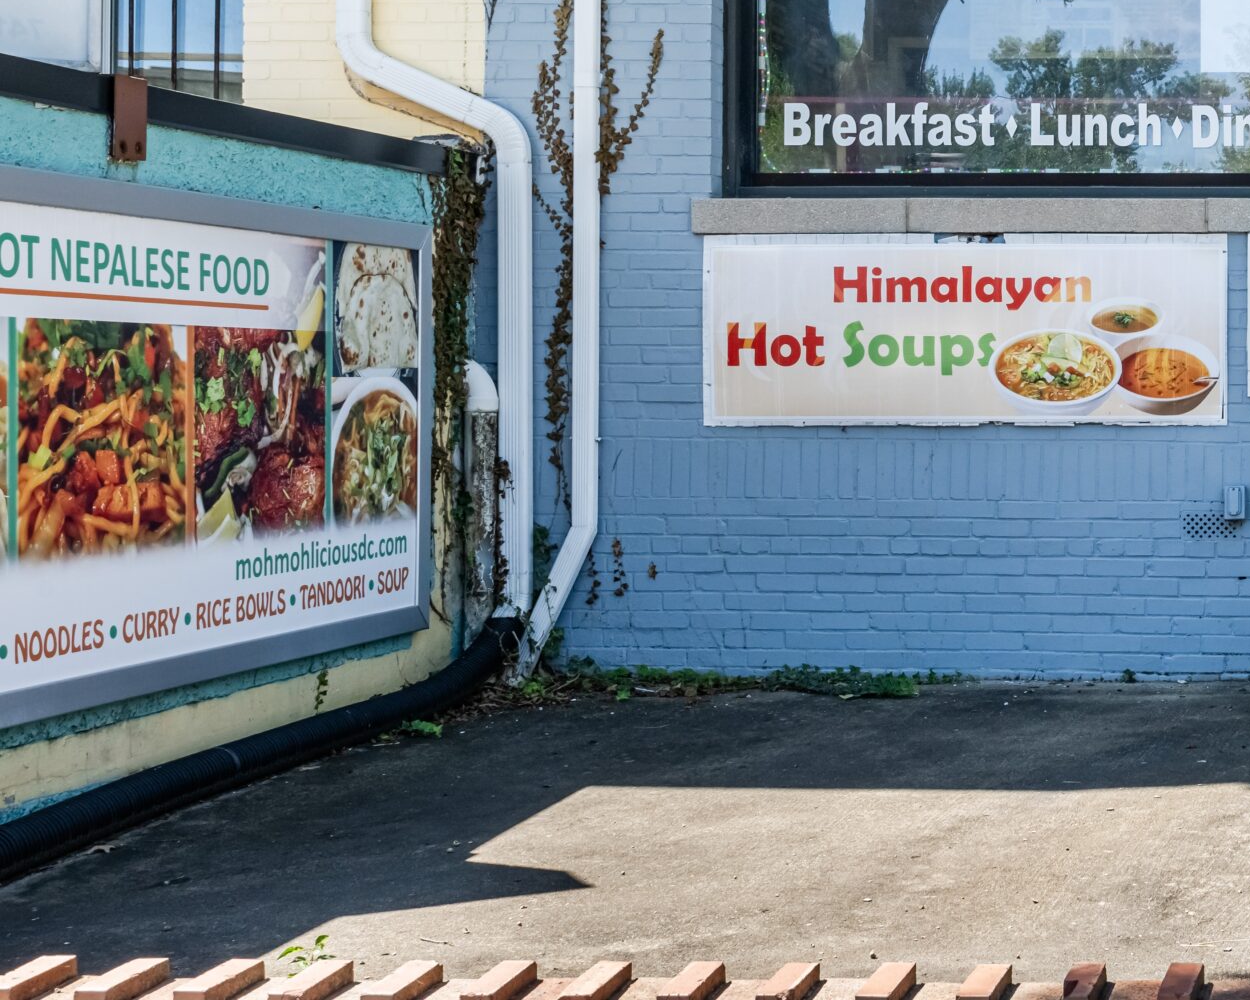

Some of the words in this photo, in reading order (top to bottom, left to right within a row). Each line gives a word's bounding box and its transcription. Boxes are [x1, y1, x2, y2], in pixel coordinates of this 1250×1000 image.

[783, 102, 996, 148] Breakfast
[1029, 102, 1162, 147] Lunch
[50, 238, 191, 292] NEPALESE
[199, 252, 271, 297] FOOD
[833, 266, 1092, 311] Himalayan
[727, 322, 825, 367] Hot
[843, 320, 998, 377] Soups
[235, 532, 408, 581] mohmohliciousdc.com
[14, 619, 104, 665] NOODLES
[122, 606, 180, 643] CURRY
[196, 599, 231, 630] RICE
[236, 588, 286, 624] BOWLS
[300, 573, 365, 610] TANDOORI
[377, 567, 409, 596] SOUP
